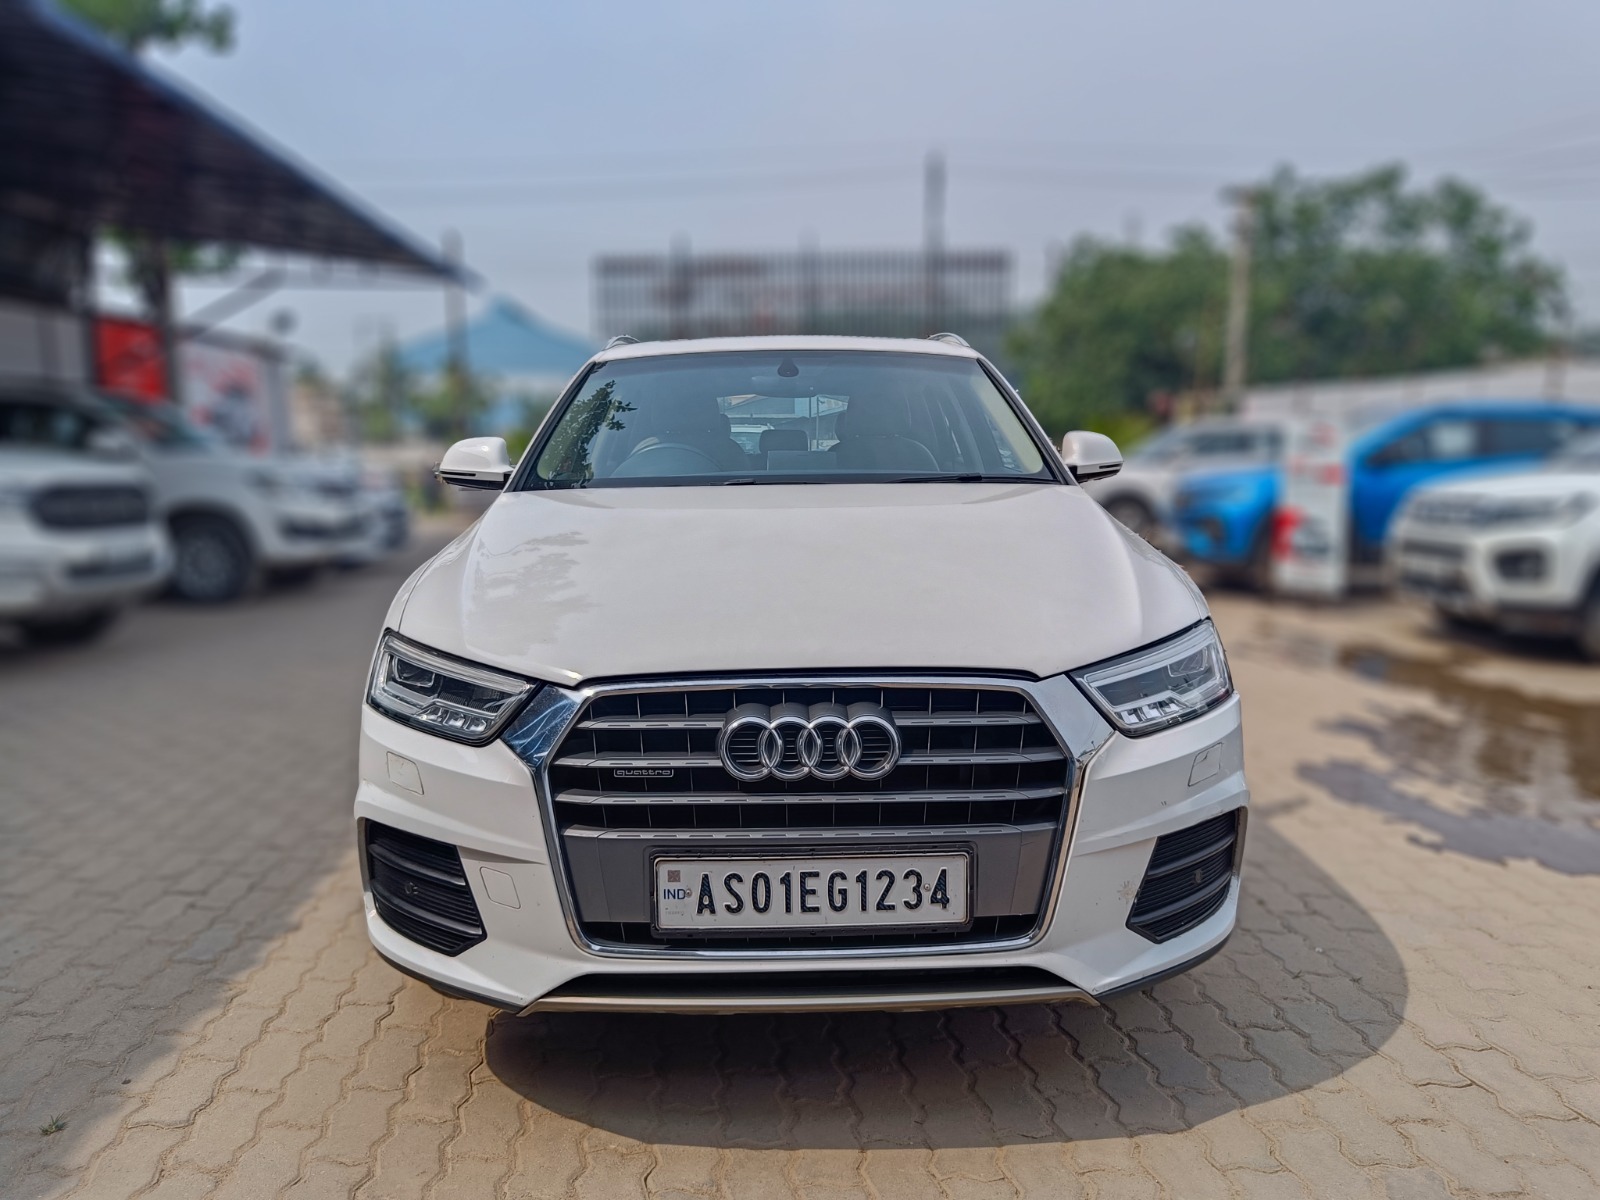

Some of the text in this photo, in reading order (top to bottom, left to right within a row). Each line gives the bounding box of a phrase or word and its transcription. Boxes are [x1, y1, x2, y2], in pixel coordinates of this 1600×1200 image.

[616, 769, 671, 777] quattro
[663, 888, 686, 900] IND
[696, 868, 950, 915] AS01EG1234
